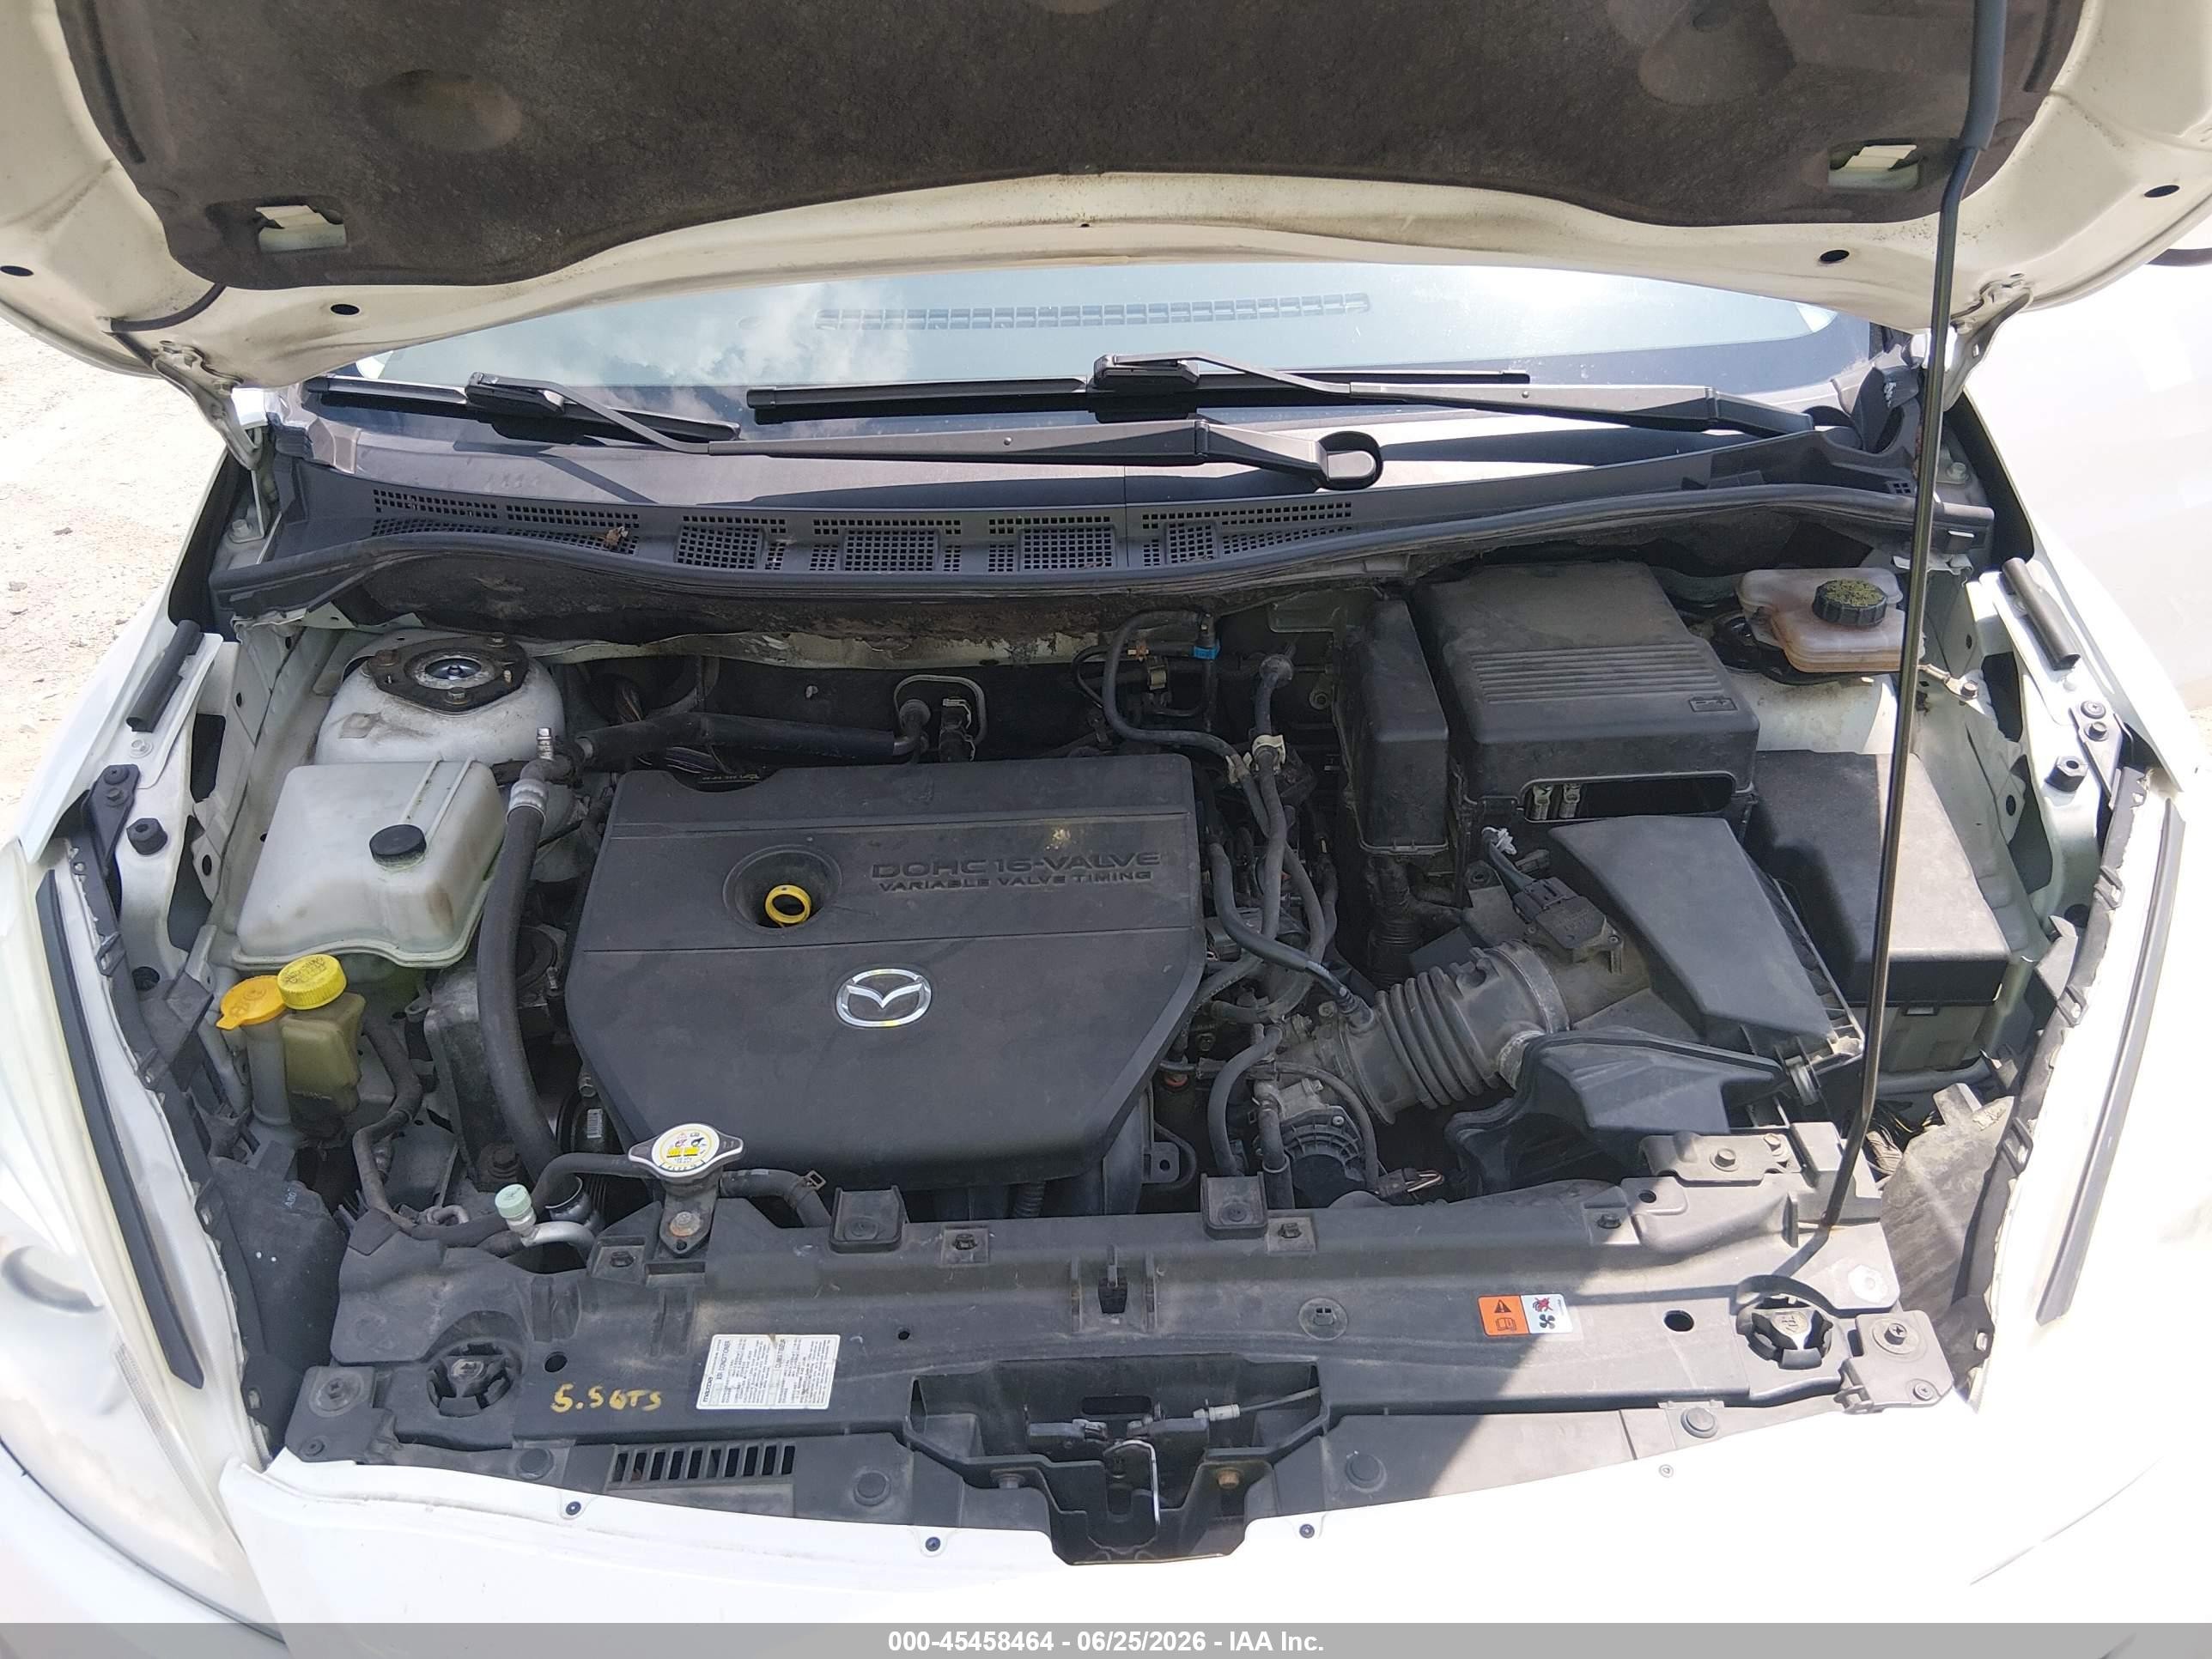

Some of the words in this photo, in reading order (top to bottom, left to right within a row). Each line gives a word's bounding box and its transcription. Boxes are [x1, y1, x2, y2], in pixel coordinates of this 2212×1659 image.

[872, 859, 987, 879] DOHC
[994, 851, 1160, 874] 16-VALVE
[878, 878, 989, 892] VARIABLE
[998, 874, 1066, 886] VALVE
[1073, 871, 1152, 884] TIMING
